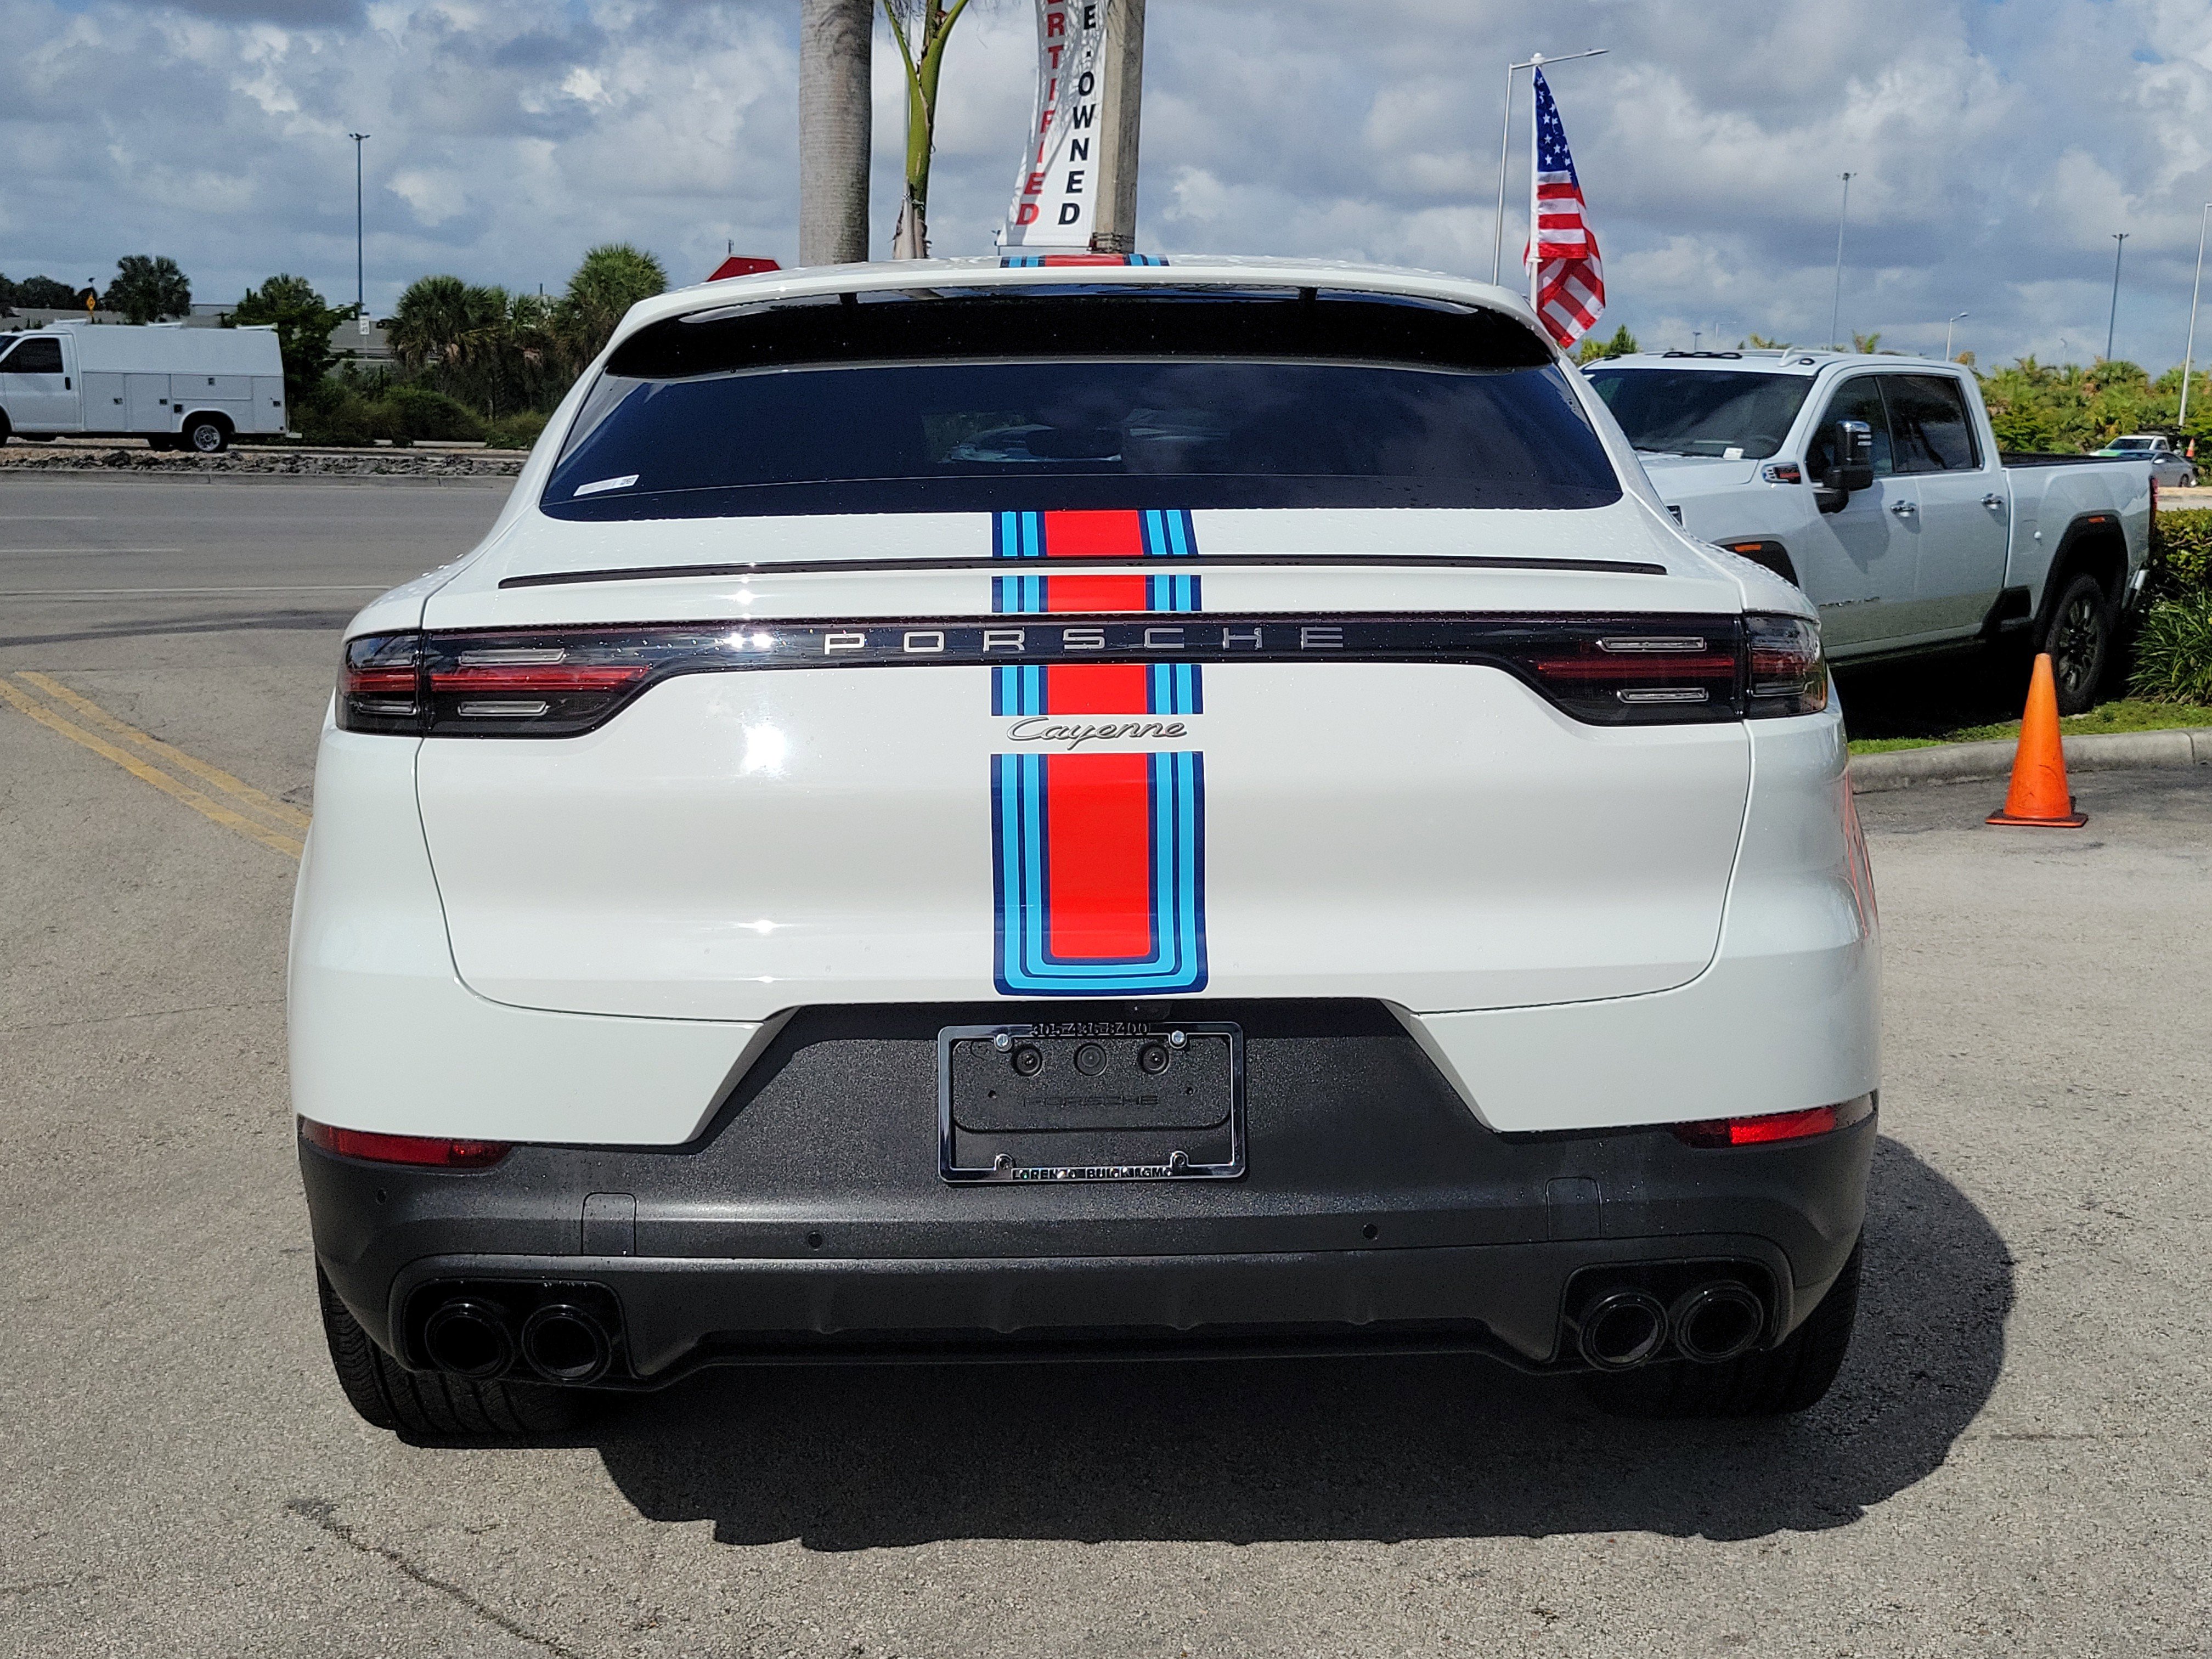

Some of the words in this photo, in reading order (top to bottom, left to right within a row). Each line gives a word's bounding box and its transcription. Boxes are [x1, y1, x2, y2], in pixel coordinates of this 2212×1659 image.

[1015, 0, 1065, 225] RTIFIED
[823, 627, 1344, 655] PORSCHE
[1007, 716, 1188, 751] Cayenne
